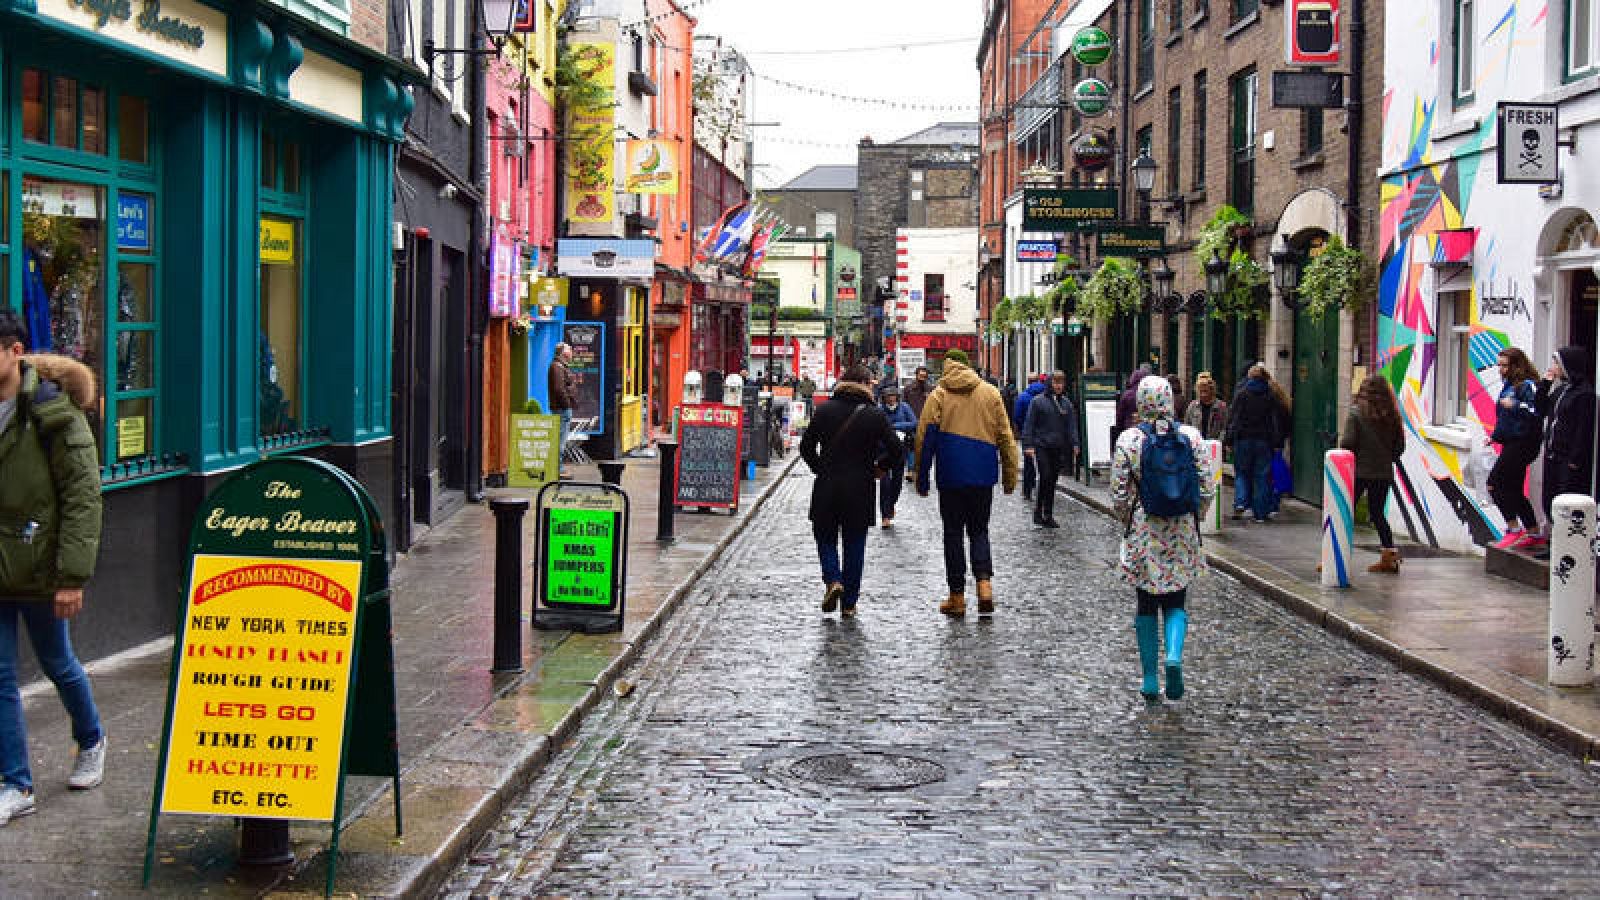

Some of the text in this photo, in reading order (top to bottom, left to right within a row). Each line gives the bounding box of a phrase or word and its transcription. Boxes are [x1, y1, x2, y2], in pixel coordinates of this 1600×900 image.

[1507, 109, 1553, 125] FRESH
[1039, 196, 1063, 206] OLD
[1029, 206, 1115, 218] STOREHOUSE
[264, 480, 303, 499] The
[205, 507, 358, 538] Eager Beaver
[553, 559, 606, 574] JUMPERS
[203, 567, 346, 603] RECOMMENDED BY
[191, 615, 349, 637] NEW YORK TIMES
[193, 671, 337, 693] ROUGH GUIDE
[203, 701, 316, 721] LETS GO
[194, 729, 319, 753] TIME OUT
[186, 757, 319, 781] HACHETTE
[212, 789, 293, 809] ETC. ETC.
